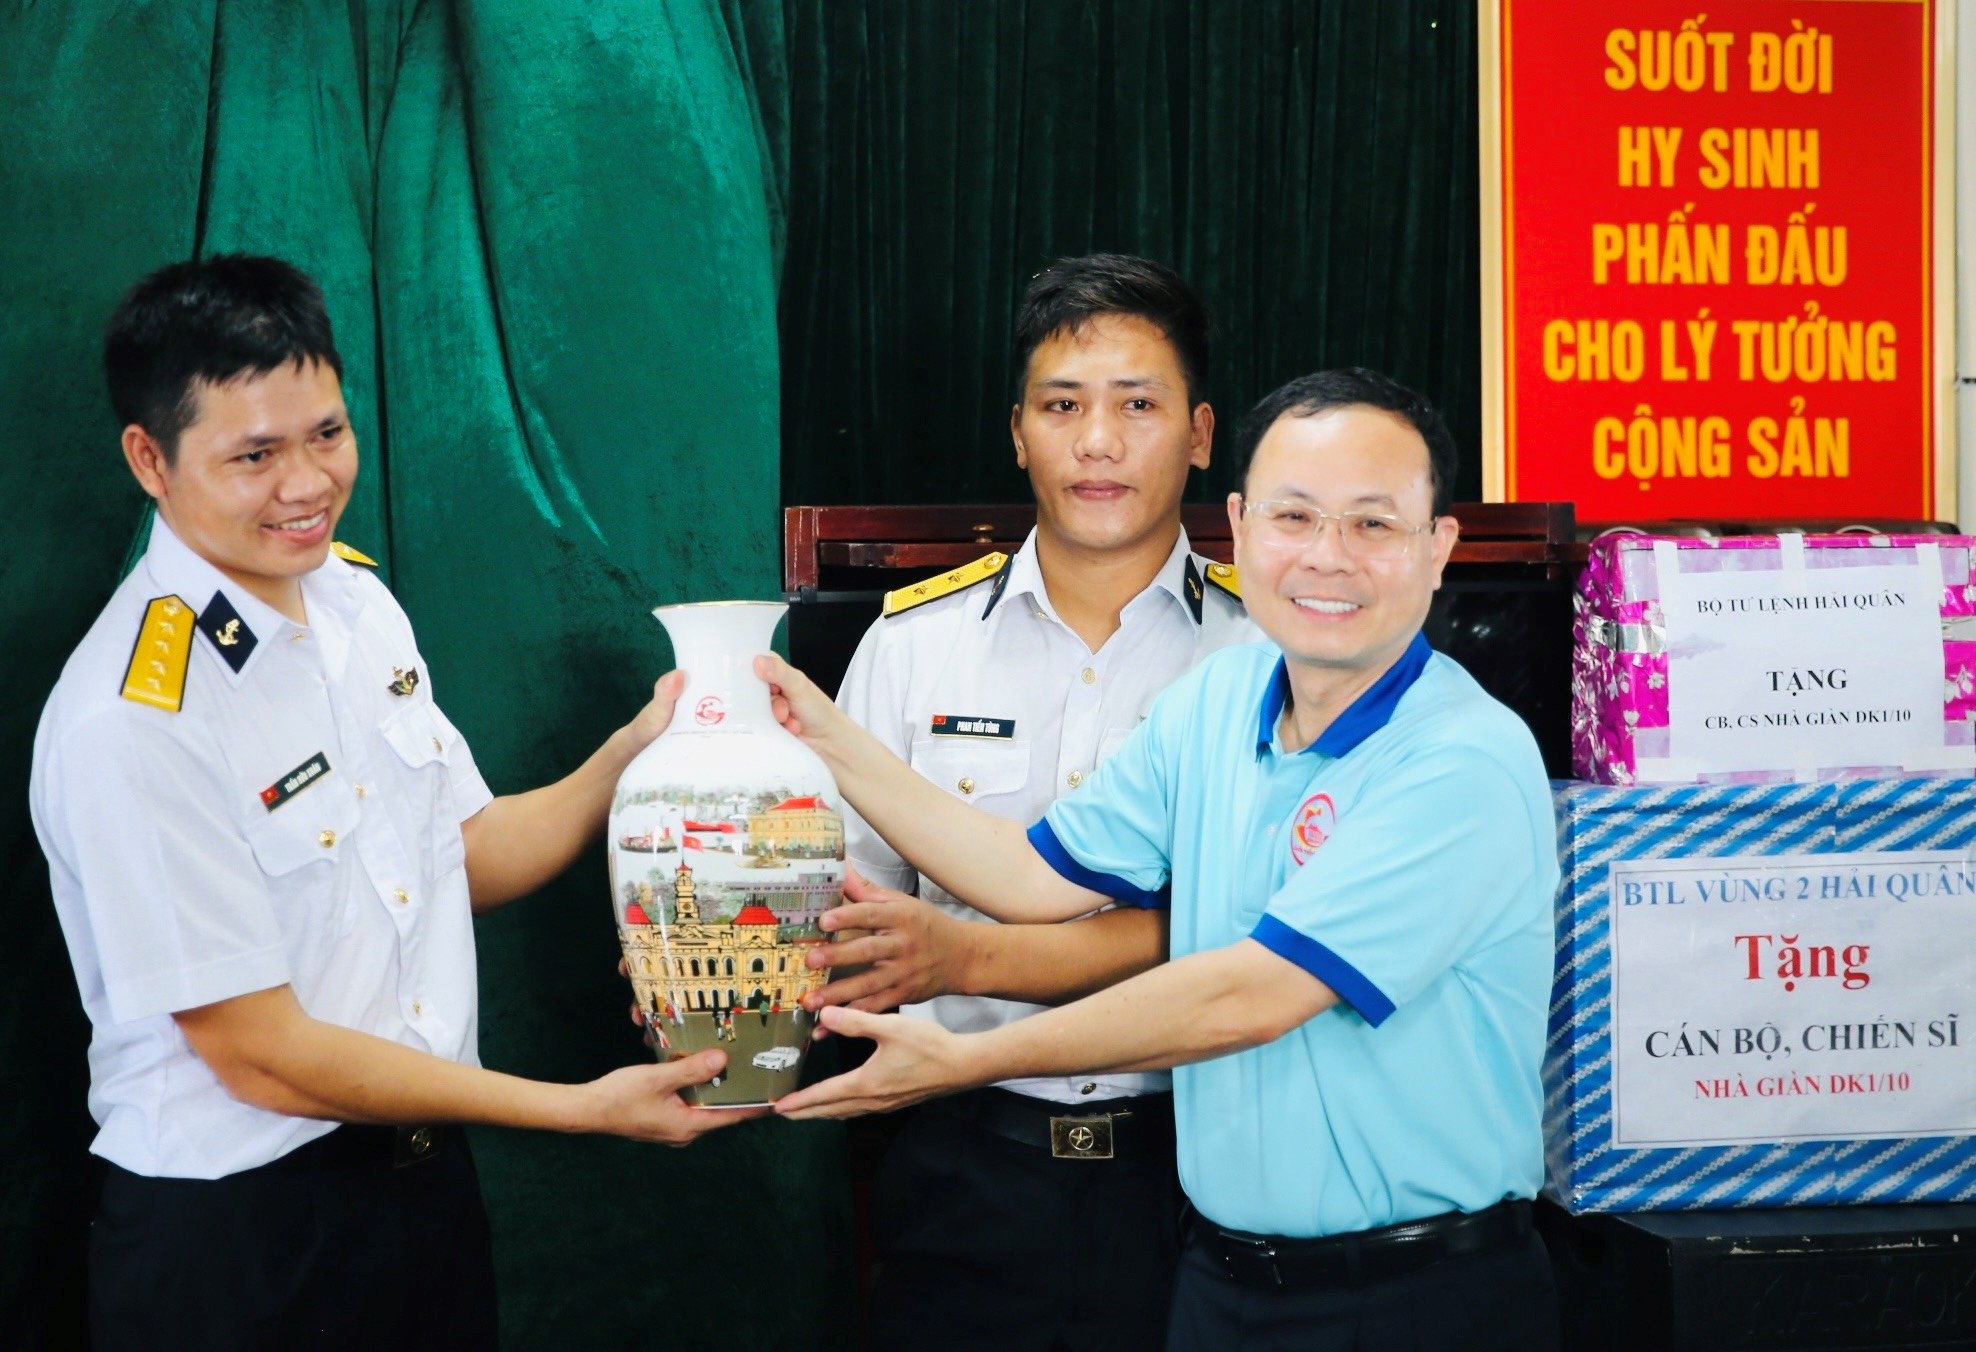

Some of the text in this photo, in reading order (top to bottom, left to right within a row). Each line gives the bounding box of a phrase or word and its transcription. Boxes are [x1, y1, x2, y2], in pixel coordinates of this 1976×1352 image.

[1604, 13, 1833, 94] SUỐT ĐỜI
[1618, 126, 1820, 190] HY SINH
[1592, 202, 1847, 287] PHẤN ĐẤU
[1543, 300, 1897, 383] CHO LÝ TƯỞNG
[1593, 396, 1849, 491] CỘNG SẢN
[1766, 668, 1847, 696] TẶNG
[1623, 865, 1976, 905] BTL VÙNG 2 HẢI QUÂN
[1735, 934, 1870, 992] Tặng
[1646, 1013, 1958, 1061] CÁN BỘ, CHIẾN SĨ
[1695, 1071, 1909, 1098] NHÀ GIÀN DK1/10
